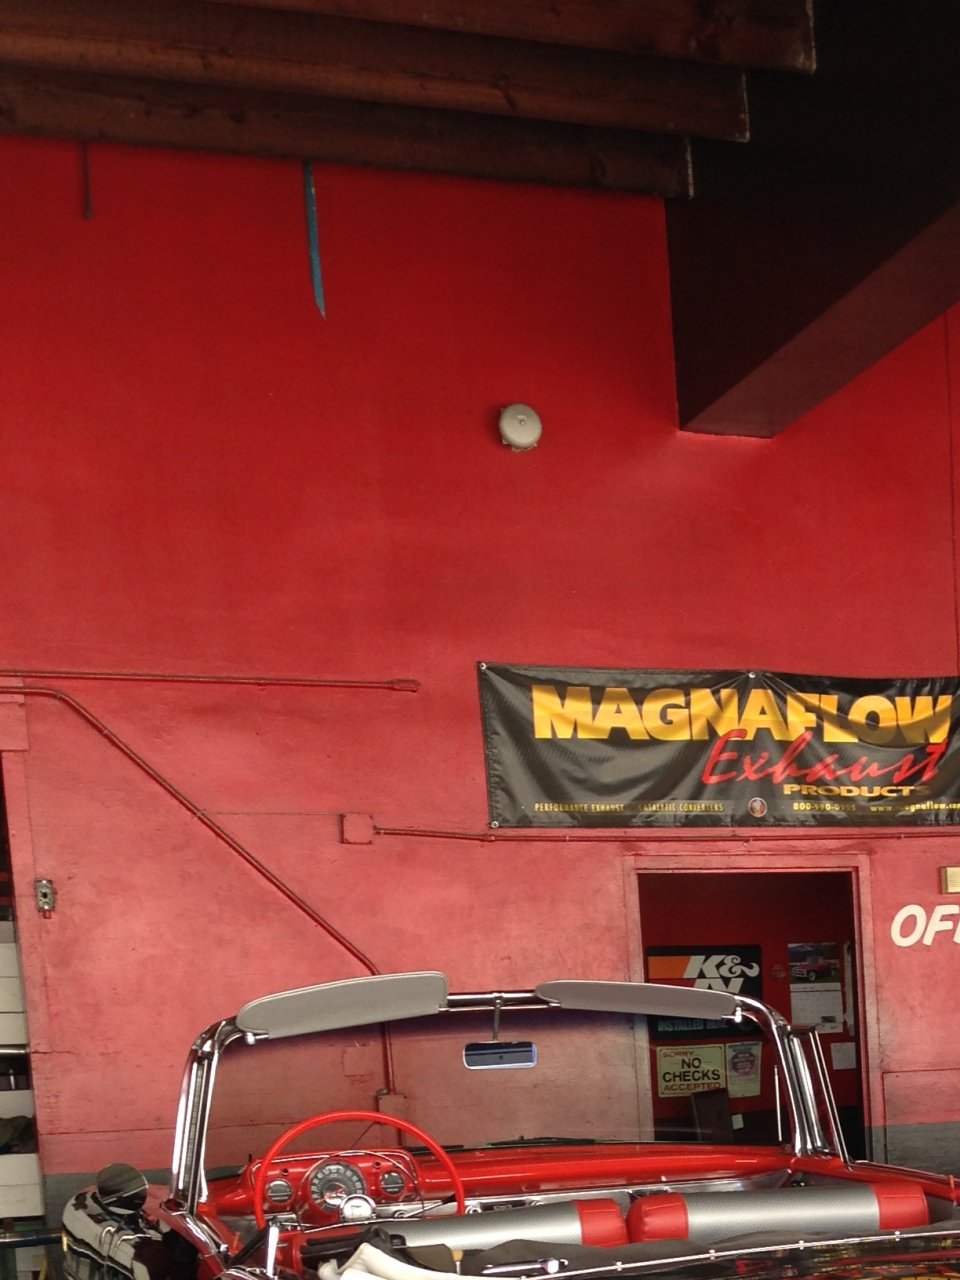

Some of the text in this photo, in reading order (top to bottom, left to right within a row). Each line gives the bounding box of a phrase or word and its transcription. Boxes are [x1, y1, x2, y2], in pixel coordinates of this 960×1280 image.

[531, 684, 953, 744] MAGNAFLOW
[702, 728, 949, 785] Exhaust
[783, 784, 930, 797] PRODUCTS
[681, 1057, 702, 1069] NO
[662, 1069, 720, 1083] CHECKS
[663, 1082, 721, 1092] ACCEPTED
